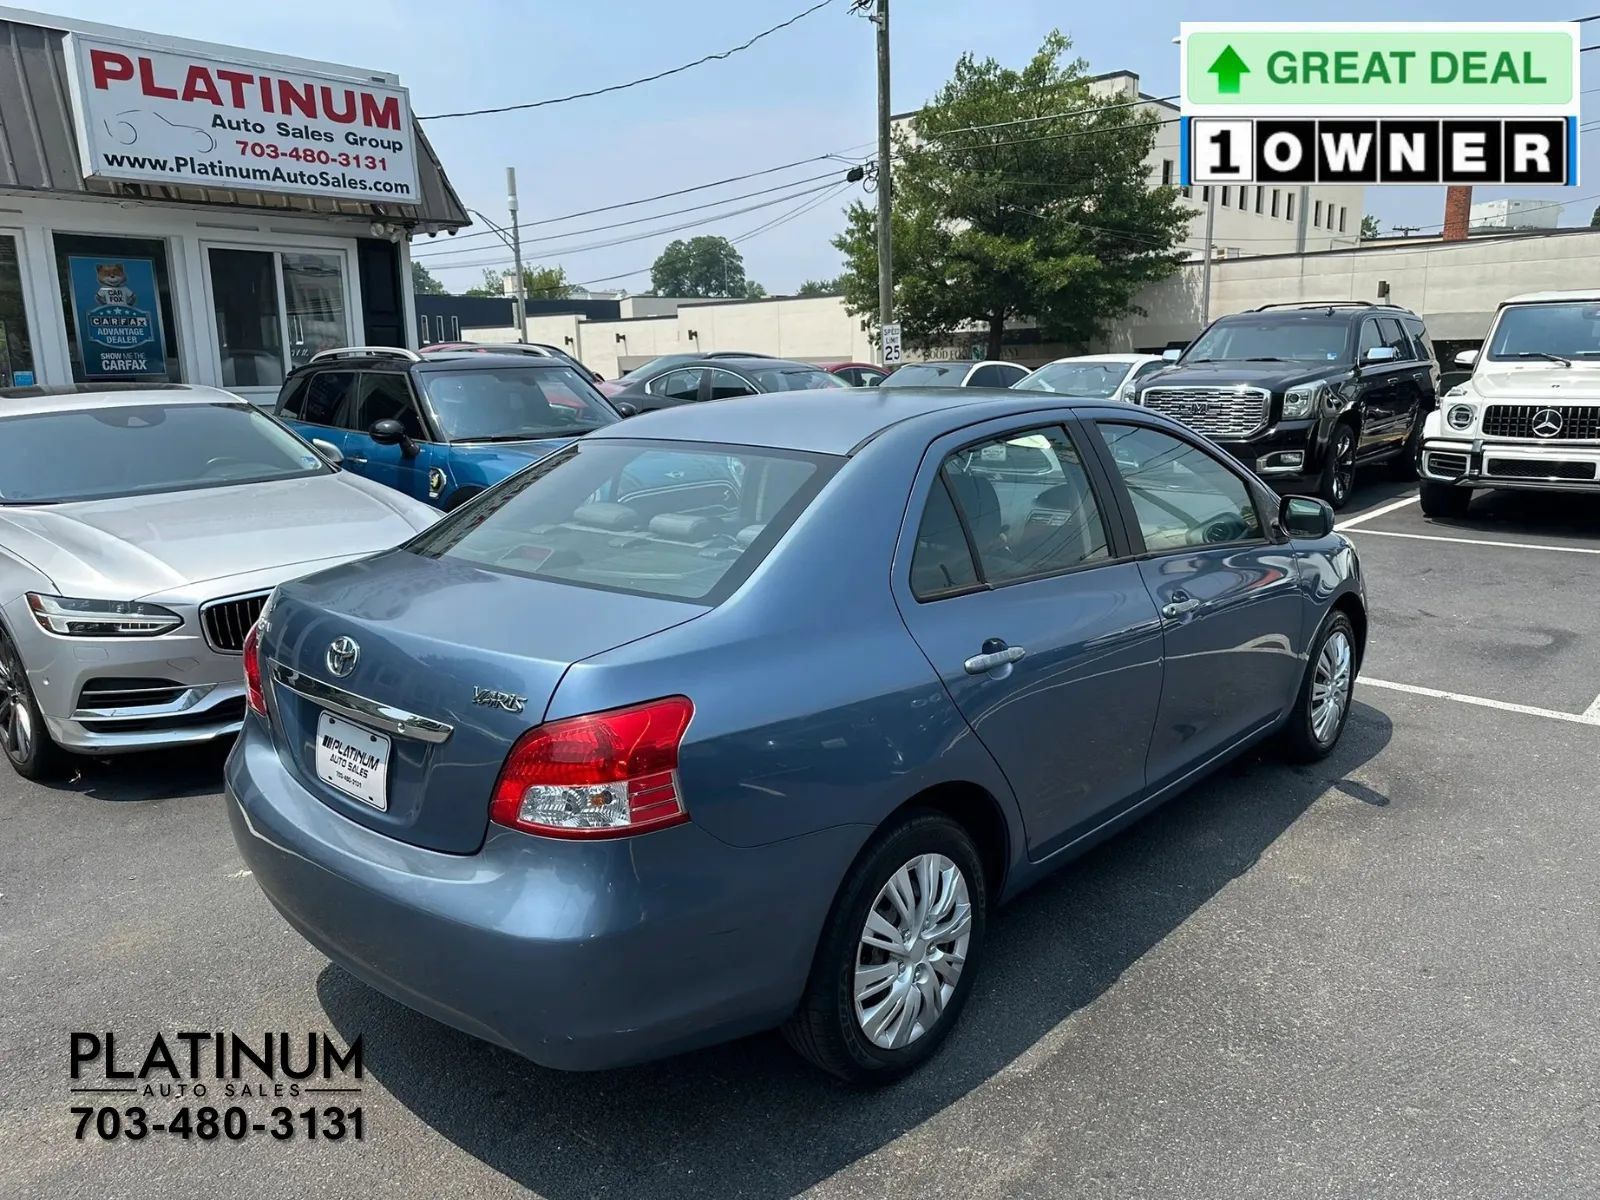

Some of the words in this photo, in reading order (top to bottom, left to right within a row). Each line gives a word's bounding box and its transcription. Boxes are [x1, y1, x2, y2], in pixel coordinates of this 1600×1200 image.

[90, 49, 401, 131] PLATINUM
[211, 114, 265, 134] Auto
[277, 122, 334, 143] Sales
[345, 132, 403, 153] Group
[235, 140, 388, 171] 703-480-3131
[104, 154, 410, 194] www.PlatinumAutoSales.com
[98, 328, 144, 336] ADVANTAGE
[102, 360, 147, 370] CARFAX
[885, 345, 900, 360] 25
[1179, 402, 1222, 414] GMC
[472, 685, 528, 713] YARIS
[329, 754, 347, 768] AUTO
[348, 763, 369, 779] SALES
[331, 739, 380, 771] PLATINUM
